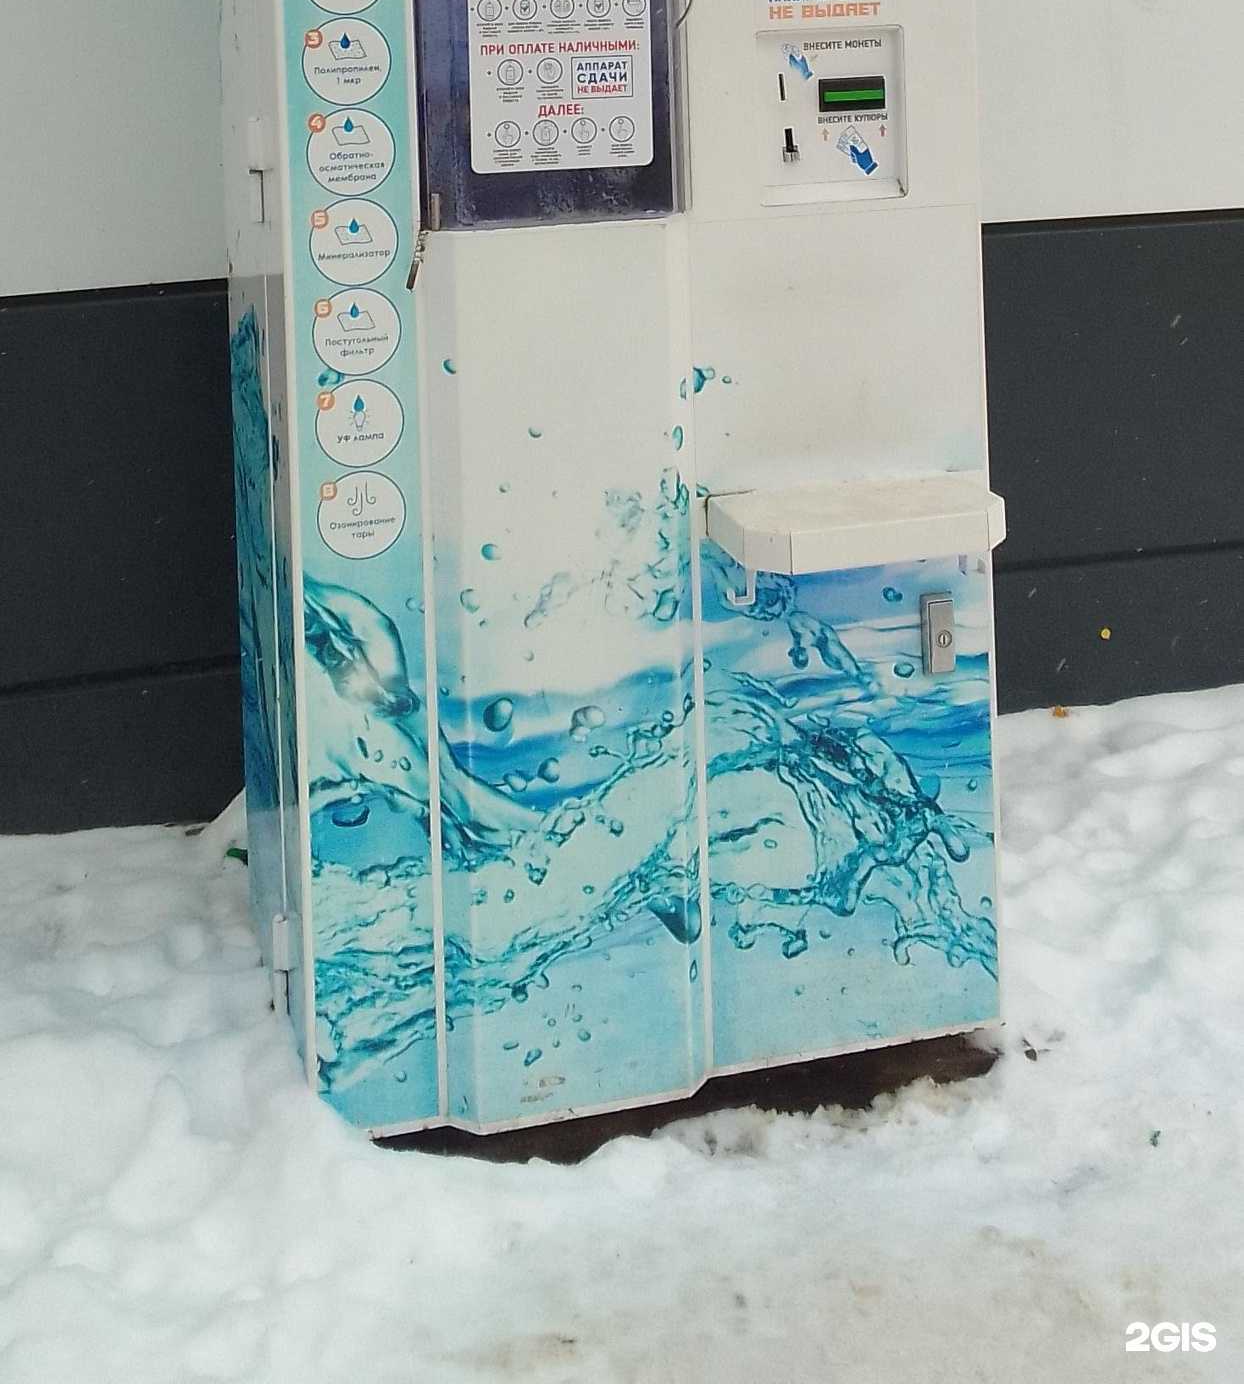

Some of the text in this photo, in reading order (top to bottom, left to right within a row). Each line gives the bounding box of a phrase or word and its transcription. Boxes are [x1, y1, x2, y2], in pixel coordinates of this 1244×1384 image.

[769, 2, 881, 19] НЕ ВЫДАЕТ
[480, 39, 640, 56] ПРИ ОПЛАТЕ НАЛИЧНЫМИ:
[803, 39, 882, 51] ВНЕСИТЕ МОНЕТЫ
[576, 60, 628, 72] АППАРАТ
[577, 72, 628, 84] СДАЧИ
[577, 84, 627, 94] НЕ ВЫДАЕТ
[538, 104, 584, 118] ДАЛЕЕ:
[818, 114, 888, 124] ВНЕСИТЕ КУПЮРЫ
[329, 151, 374, 161] Обратно-
[327, 173, 377, 183] мембрана
[318, 250, 391, 261] Минерализатор
[325, 334, 389, 346] Постугольный
[340, 347, 375, 357] фильтр
[337, 432, 384, 444] УФ лампа
[329, 517, 396, 530] Озонирование
[352, 530, 375, 539] тары
